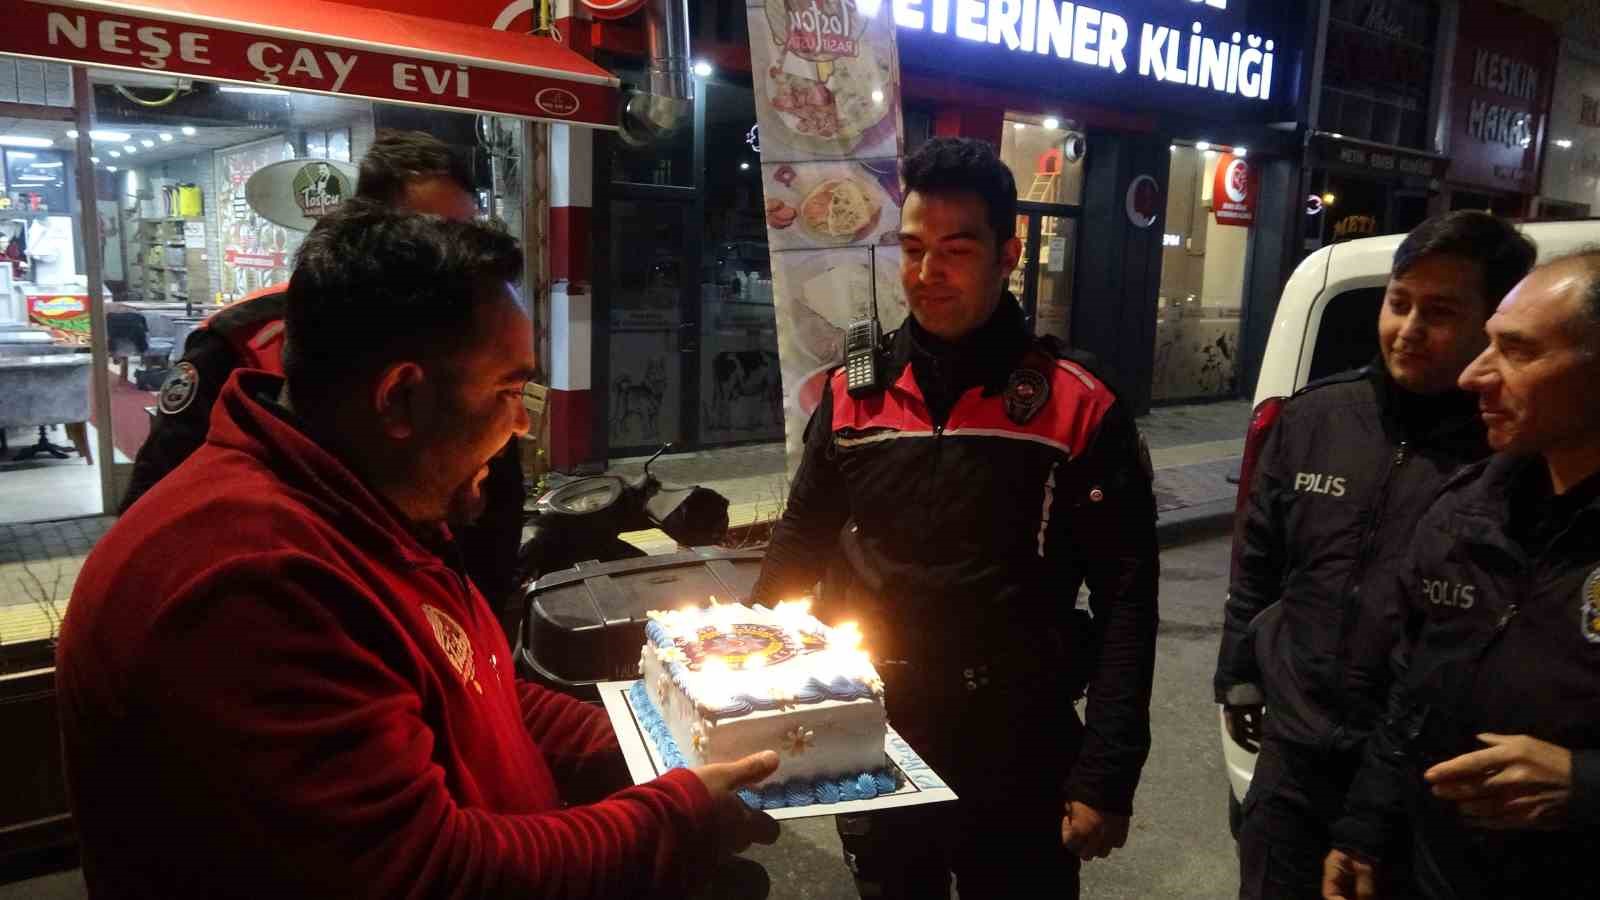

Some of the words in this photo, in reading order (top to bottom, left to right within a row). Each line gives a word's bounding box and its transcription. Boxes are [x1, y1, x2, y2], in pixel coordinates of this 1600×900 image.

[47, 12, 211, 69] NEŞE
[246, 41, 358, 93] ÇAY
[392, 63, 470, 99] EVİ
[1138, 21, 1275, 101] KLİNİĞİ
